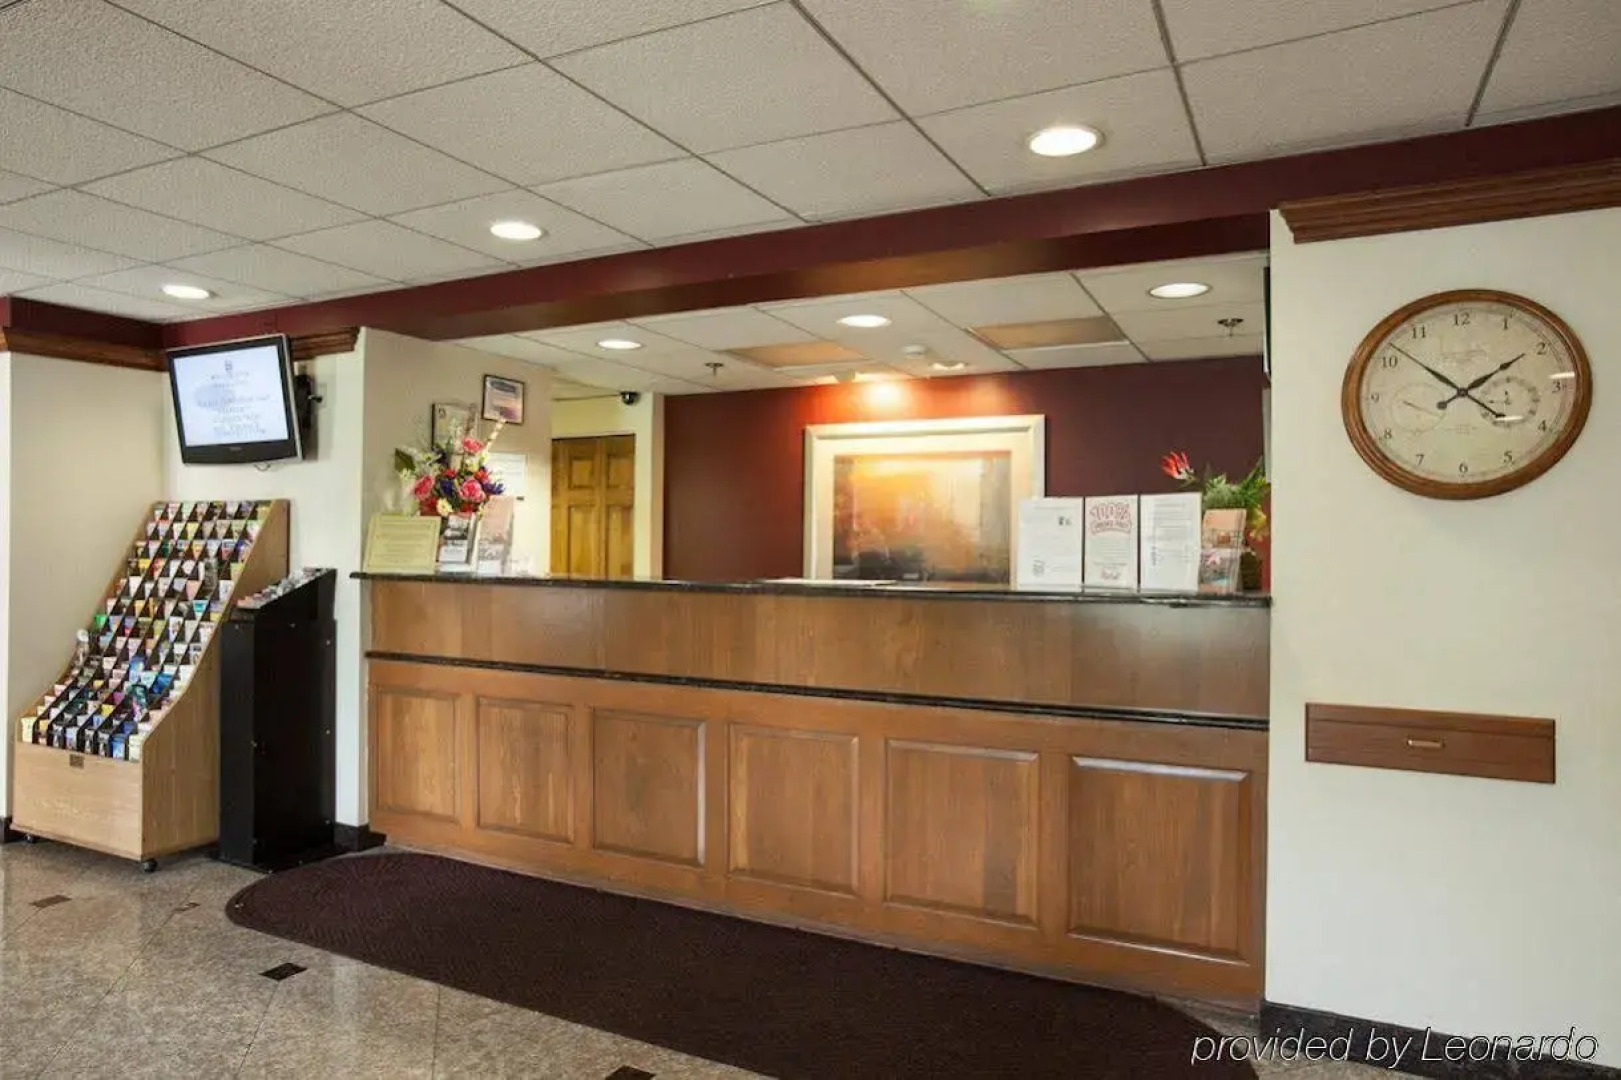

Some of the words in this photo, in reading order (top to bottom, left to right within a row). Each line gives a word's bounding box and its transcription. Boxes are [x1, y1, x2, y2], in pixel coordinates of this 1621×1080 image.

[1454, 313, 1470, 326] 12
[1502, 318, 1509, 330] 1
[1412, 327, 1427, 339] 11
[1536, 342, 1547, 355] 2
[1381, 356, 1397, 368] 10
[1552, 381, 1561, 393] 3
[1371, 394, 1379, 403] 9
[1538, 420, 1547, 432] 4
[1384, 429, 1393, 440] 8
[1416, 454, 1424, 466] 7
[1504, 451, 1512, 463] 5
[1459, 462, 1468, 473] 6
